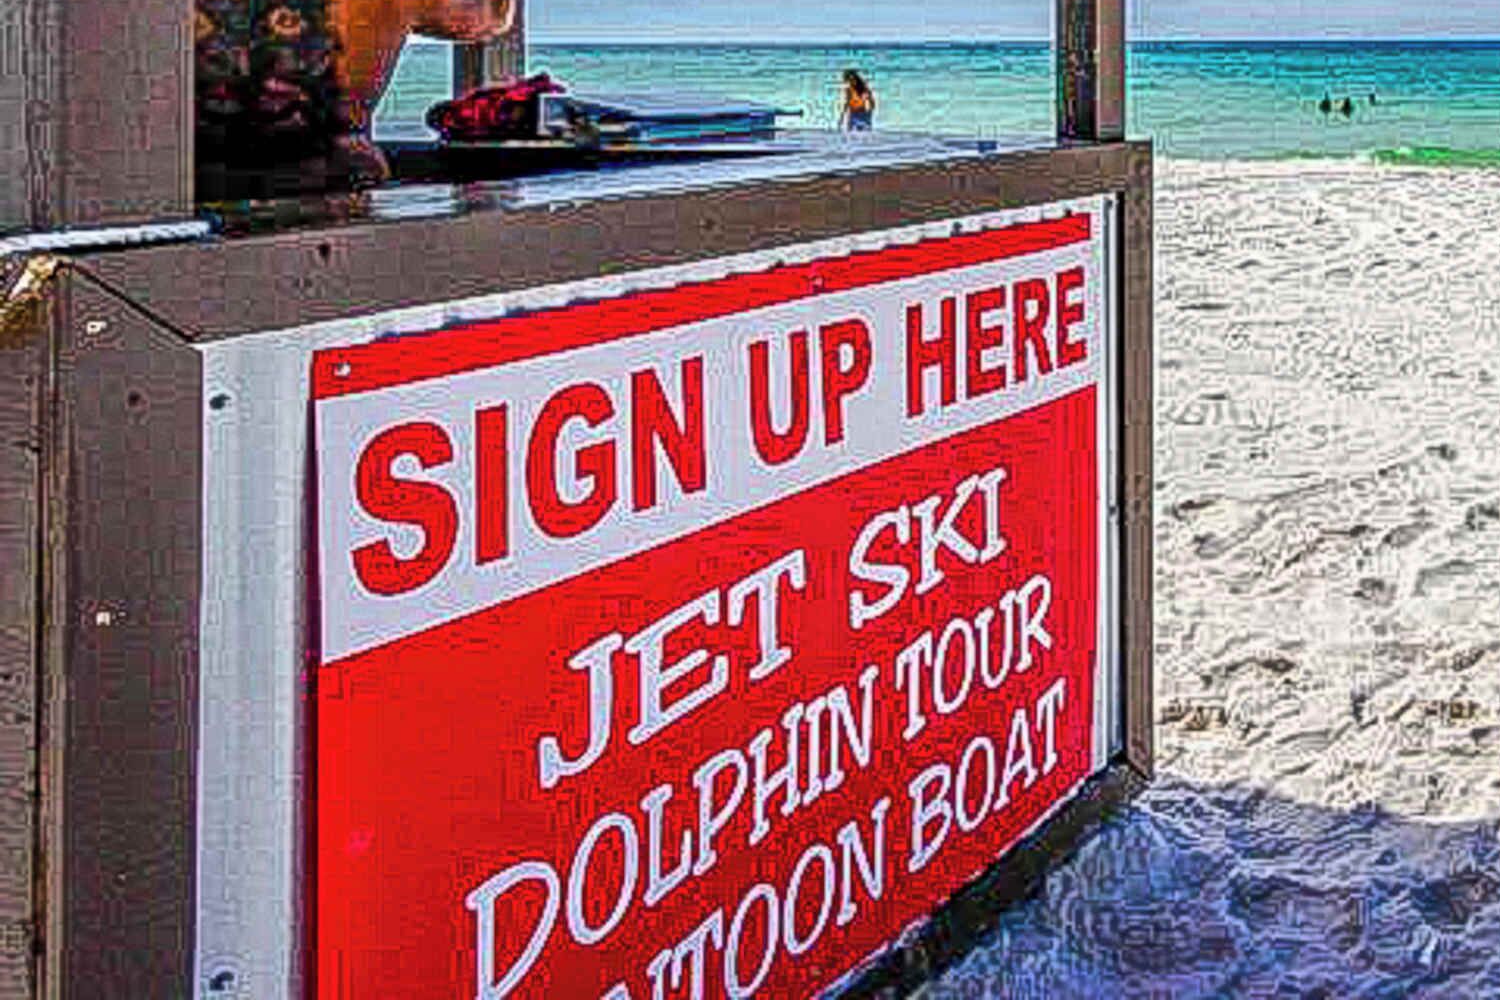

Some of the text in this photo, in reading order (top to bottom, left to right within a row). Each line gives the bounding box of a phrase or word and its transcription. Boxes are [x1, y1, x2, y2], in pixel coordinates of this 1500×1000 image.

[350, 265, 1087, 598] SIGN UP HERE
[464, 574, 1054, 1000] DOLPHIN TOUR
[538, 467, 1007, 789] JET SKI
[906, 677, 1067, 873] BOAT
